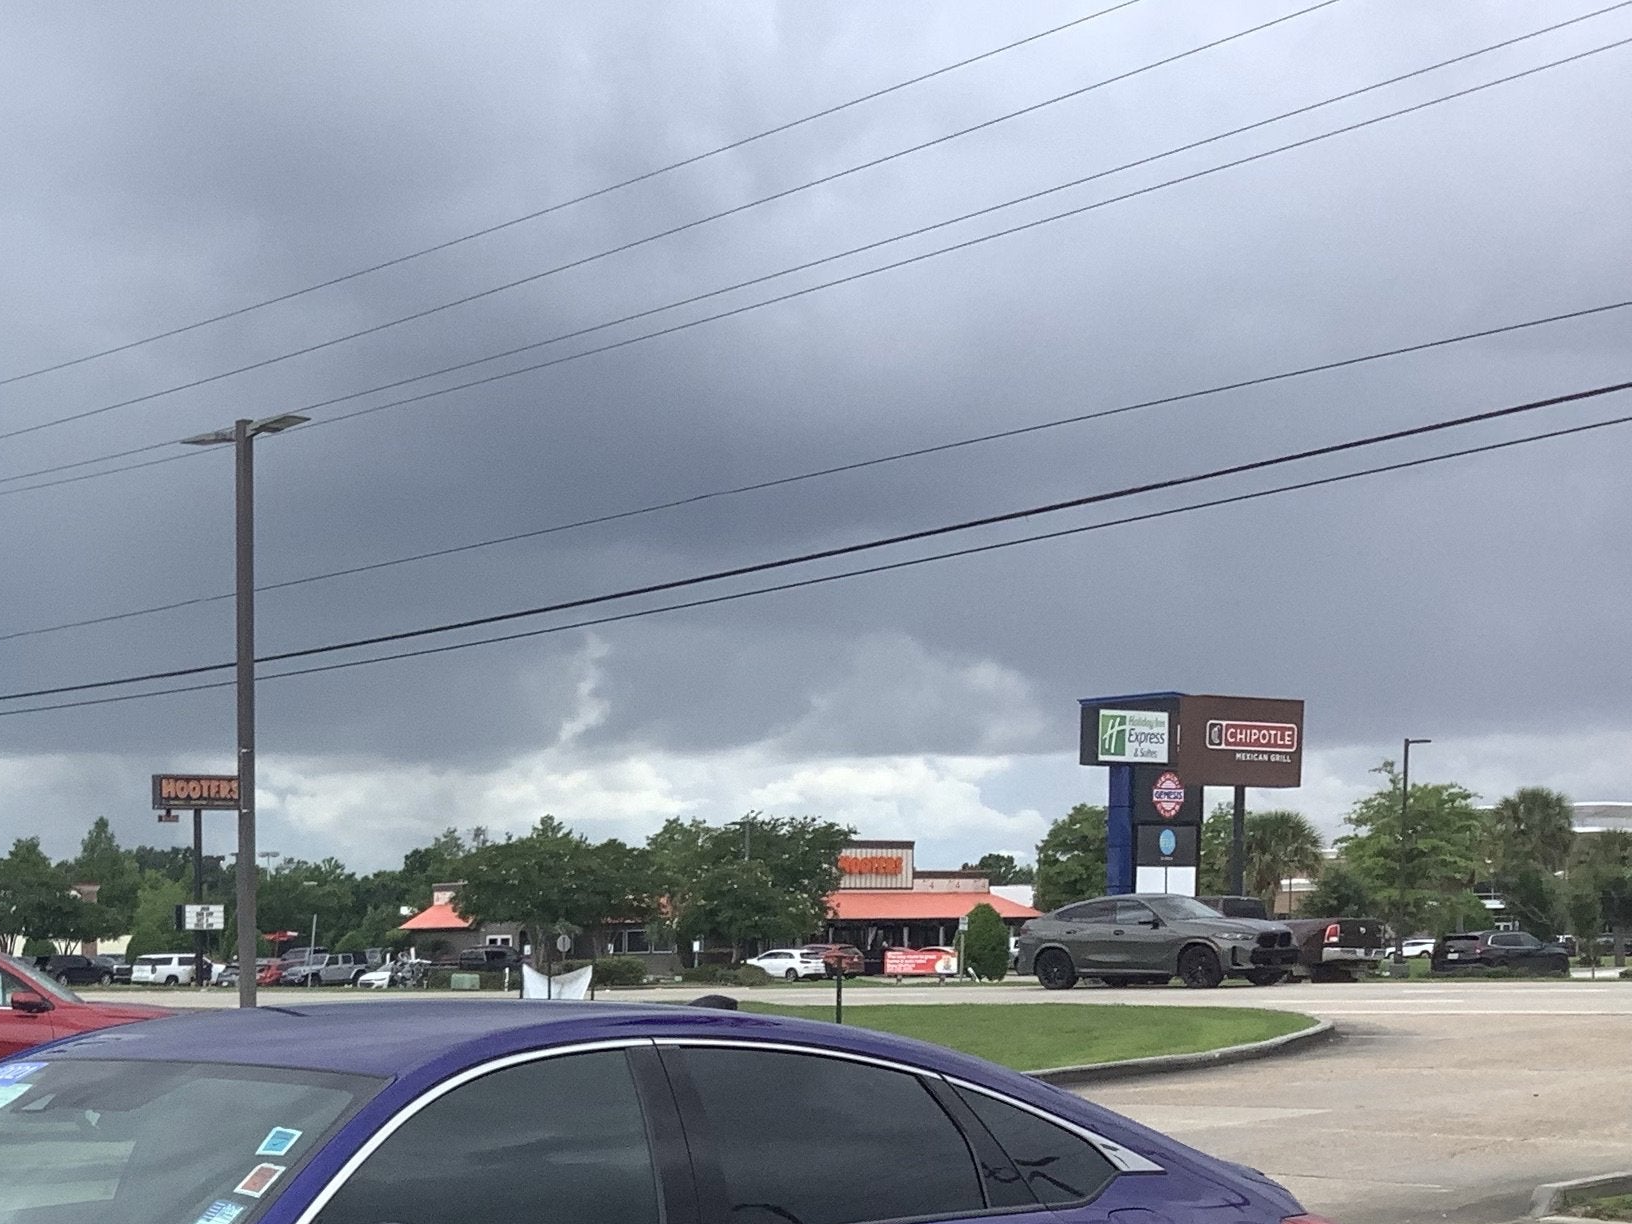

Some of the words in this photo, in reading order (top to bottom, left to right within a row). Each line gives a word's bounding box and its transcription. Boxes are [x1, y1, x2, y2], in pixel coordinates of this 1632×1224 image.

[1127, 727, 1166, 747] Express
[1226, 728, 1293, 745] CHIPOTLE
[1139, 747, 1158, 759] Suites
[1234, 752, 1269, 761] MEXICAN
[1269, 753, 1292, 763] GRILL
[161, 778, 239, 800] HOOTERS
[1154, 790, 1183, 800] GENESIS
